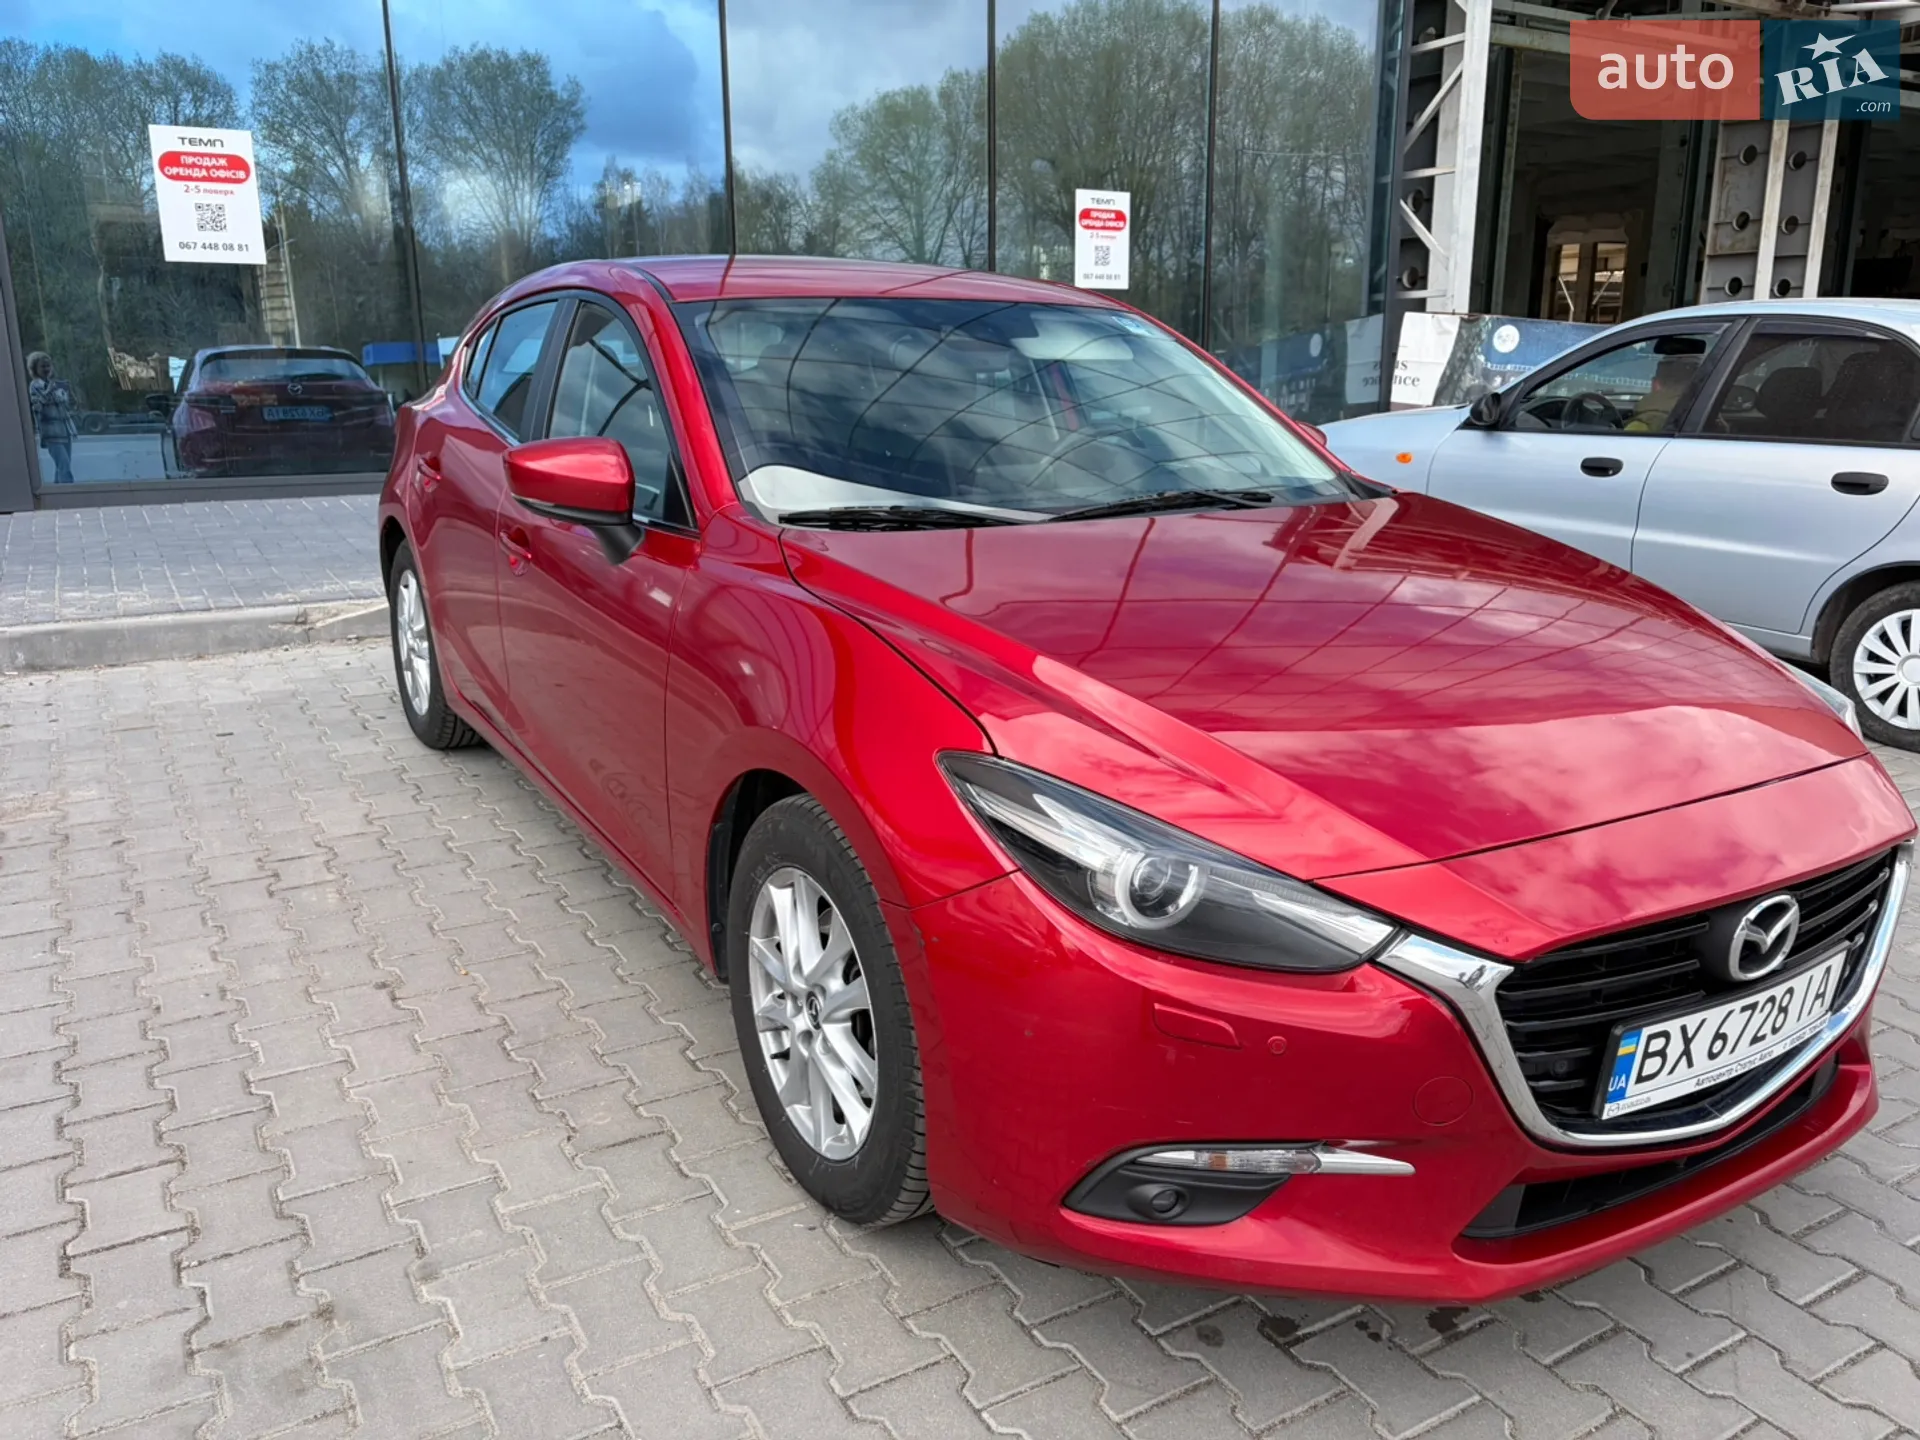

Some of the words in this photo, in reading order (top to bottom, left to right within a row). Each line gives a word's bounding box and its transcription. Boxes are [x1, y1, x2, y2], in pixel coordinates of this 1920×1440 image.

[177, 136, 225, 148] ТЕМП
[180, 154, 228, 167] ПРОДАЖ
[164, 166, 208, 179] ОРЕНДА
[209, 169, 247, 180] ОФІСІВ
[183, 184, 202, 194] 2-5
[178, 241, 198, 250] 067
[200, 242, 220, 251] 448
[222, 242, 235, 251] 08
[237, 243, 250, 252] 81
[1634, 1017, 1708, 1086] BX
[1707, 985, 1795, 1061] 6728
[1796, 963, 1833, 1023] IA
[1607, 1076, 1627, 1092] UA
